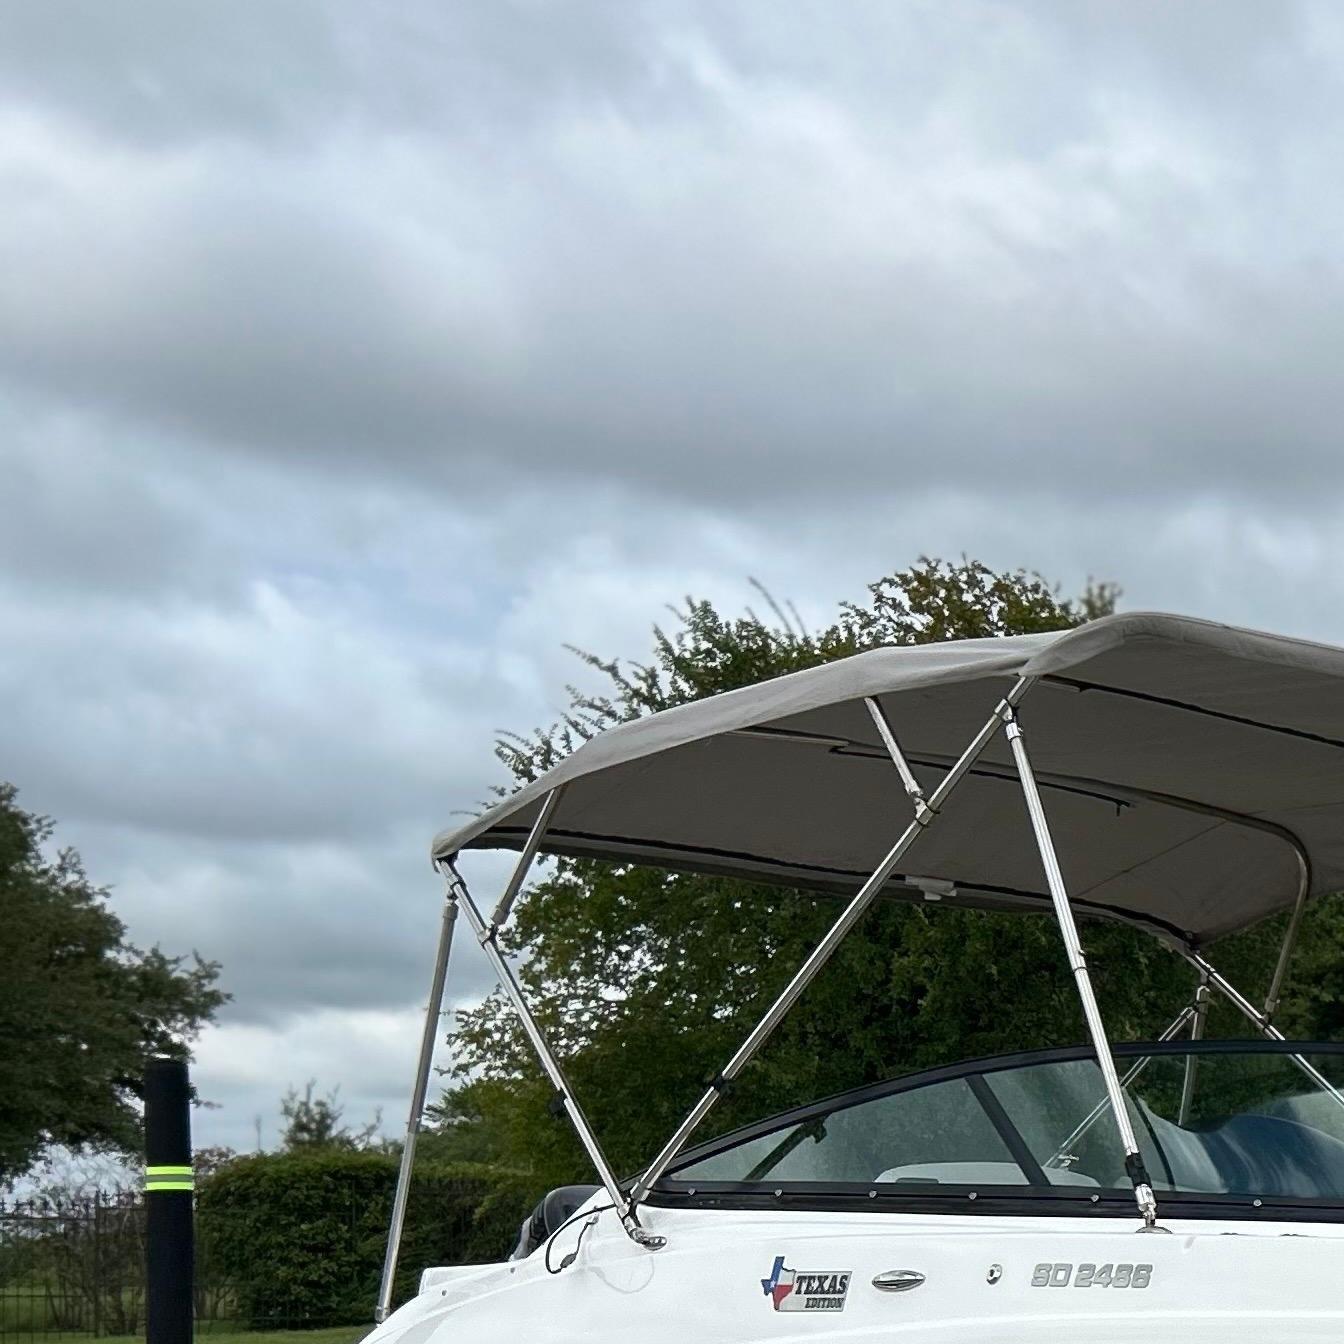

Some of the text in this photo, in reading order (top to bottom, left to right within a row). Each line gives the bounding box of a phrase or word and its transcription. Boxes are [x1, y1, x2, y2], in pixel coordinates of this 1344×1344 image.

[795, 1275, 848, 1295] TEXAS
[1031, 1263, 1153, 1288] SD 2486
[805, 1297, 845, 1309] EDITION
